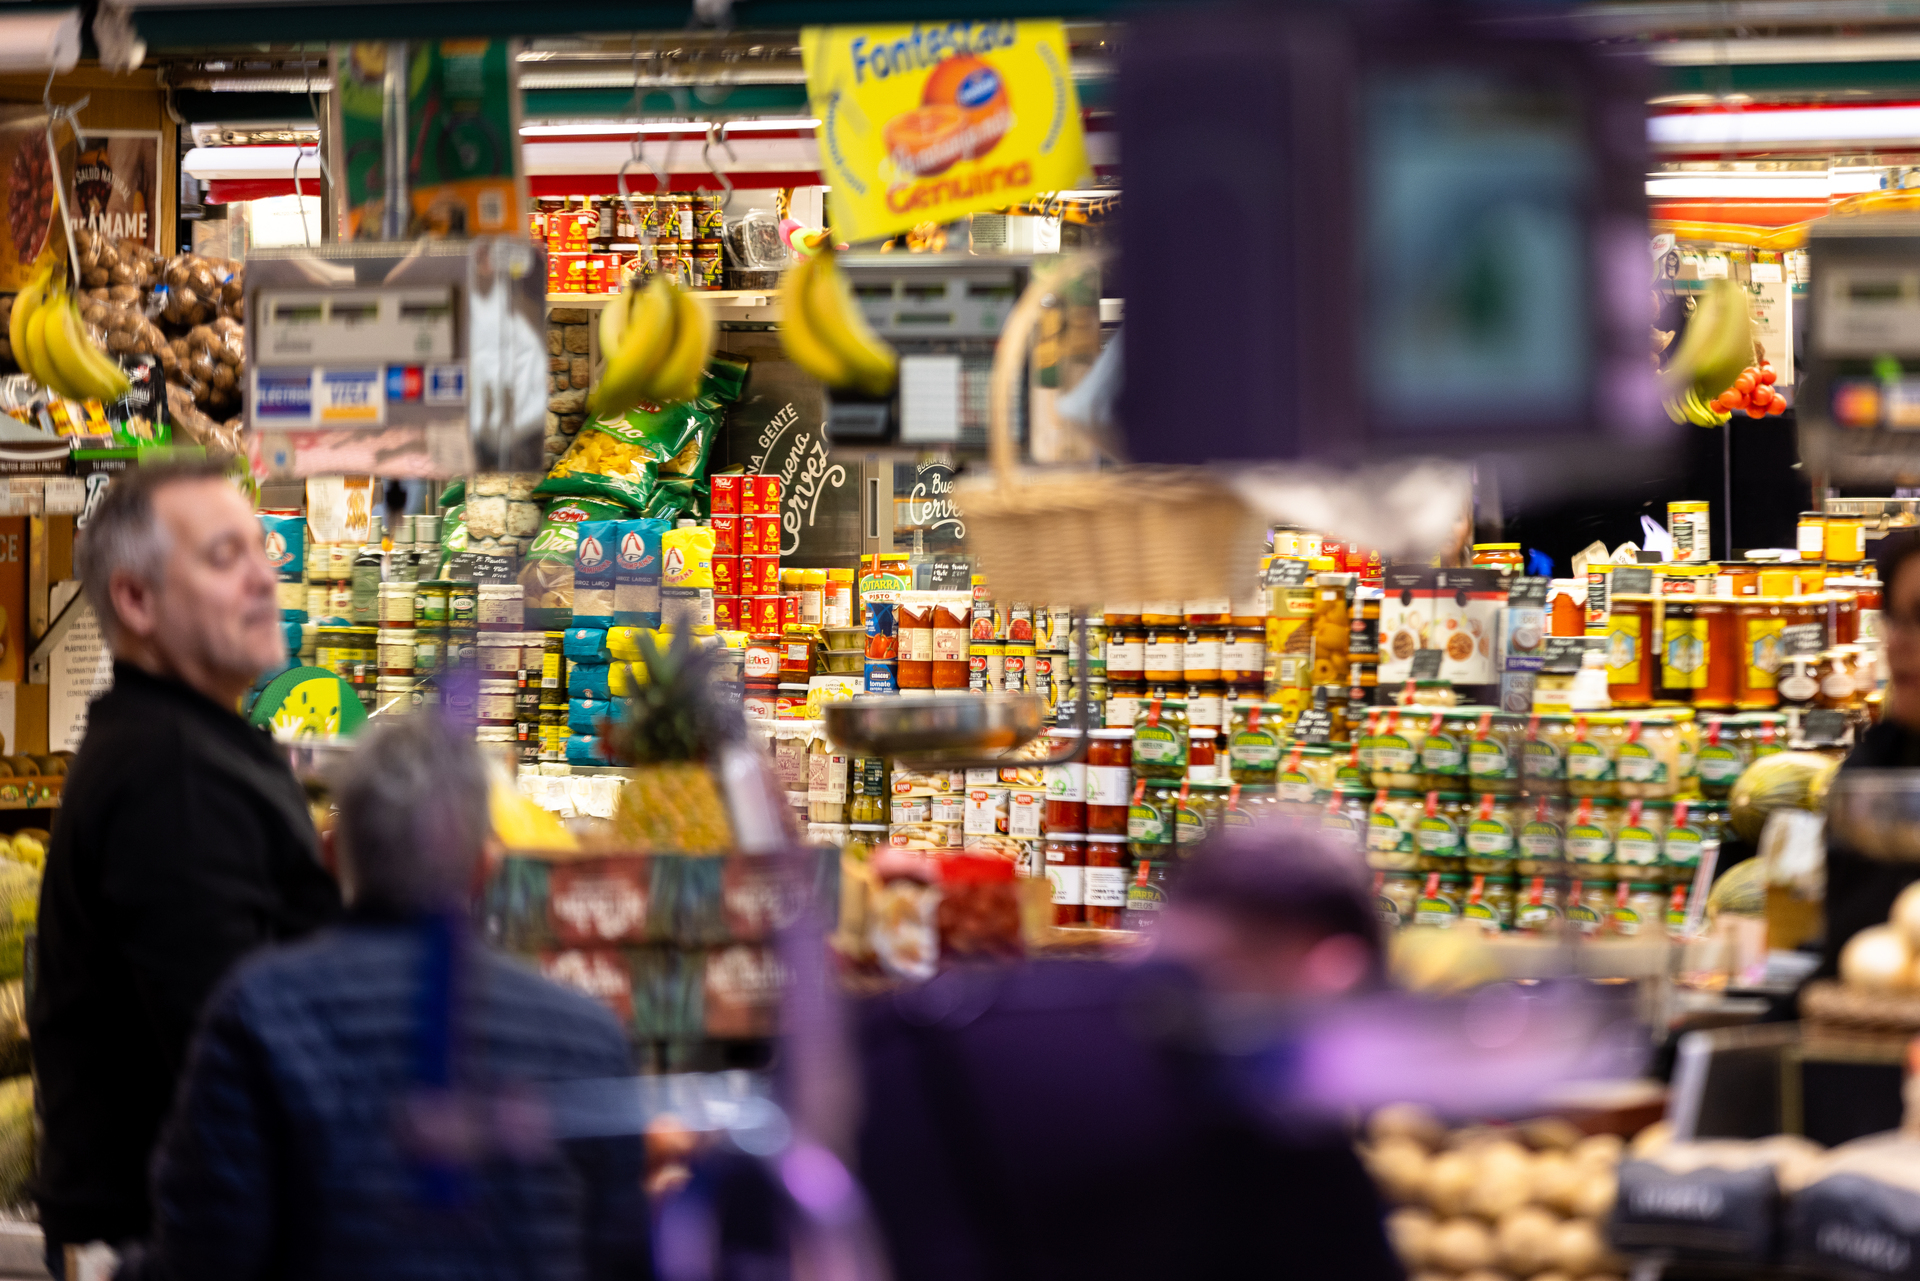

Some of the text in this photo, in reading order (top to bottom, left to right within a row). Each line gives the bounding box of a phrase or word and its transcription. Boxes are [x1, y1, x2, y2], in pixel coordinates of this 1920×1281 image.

[76, 166, 100, 184] SALUD
[757, 402, 799, 449] GENTE
[0, 461, 18, 471] RUTOS
[931, 472, 955, 495] Bue
[579, 559, 613, 575] CAMPANA
[621, 555, 655, 570] CAMPANA
[664, 568, 695, 584] CAMPANA
[1006, 660, 1020, 668] hida
